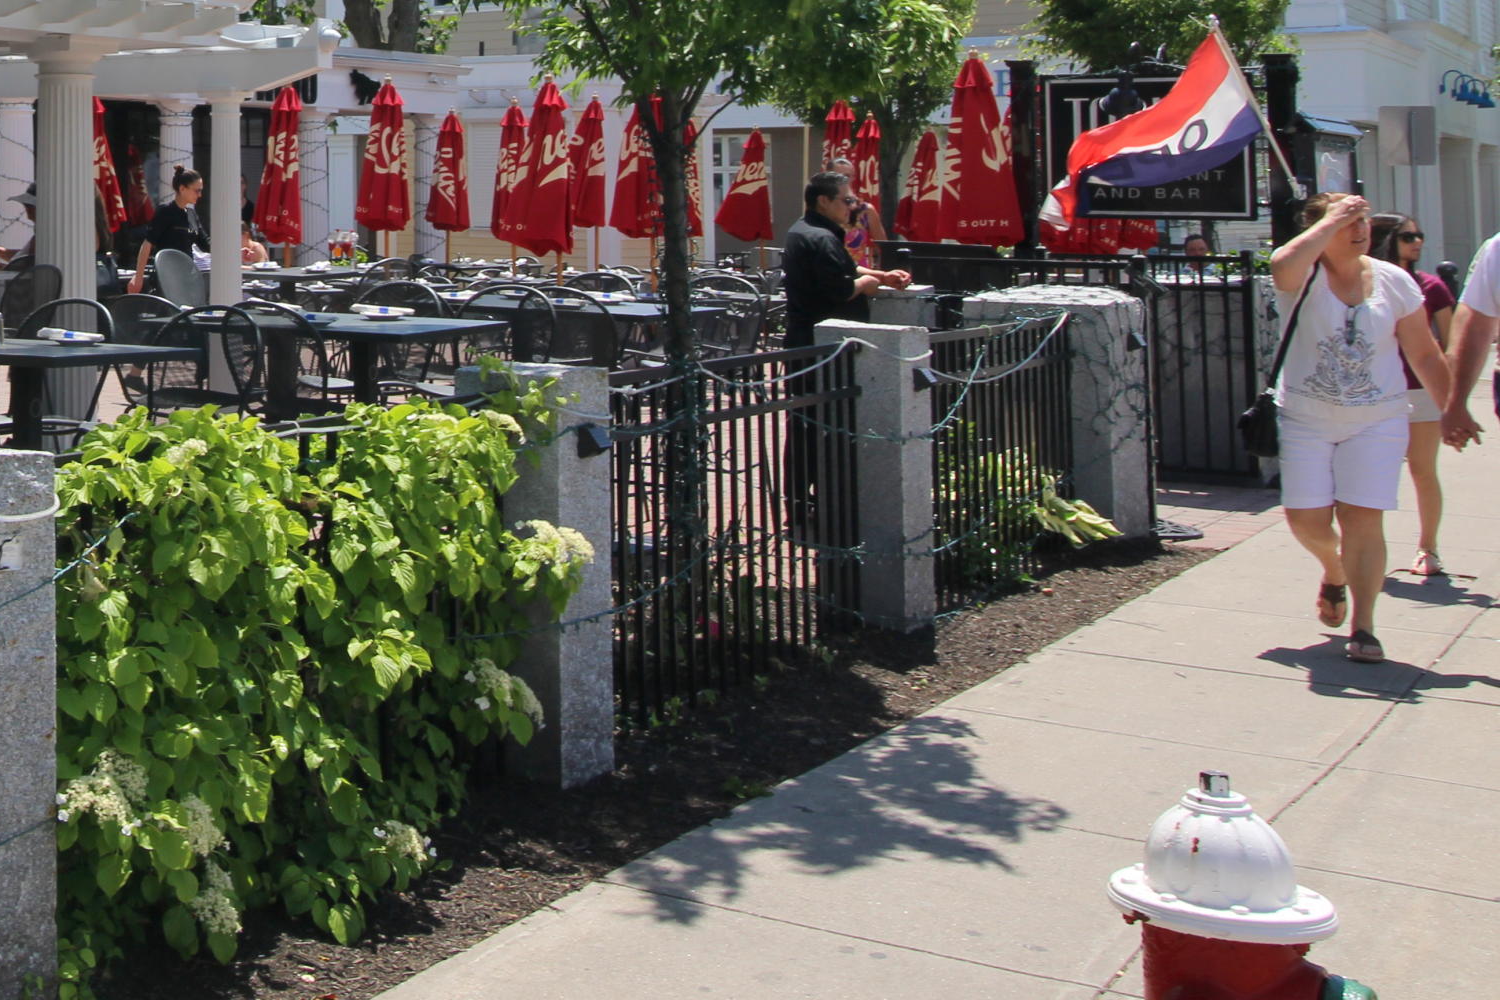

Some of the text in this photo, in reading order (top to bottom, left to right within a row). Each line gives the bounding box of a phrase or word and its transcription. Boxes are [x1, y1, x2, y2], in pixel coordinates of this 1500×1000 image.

[1093, 187, 1201, 199] AND BAR
[970, 219, 996, 228] OUT
